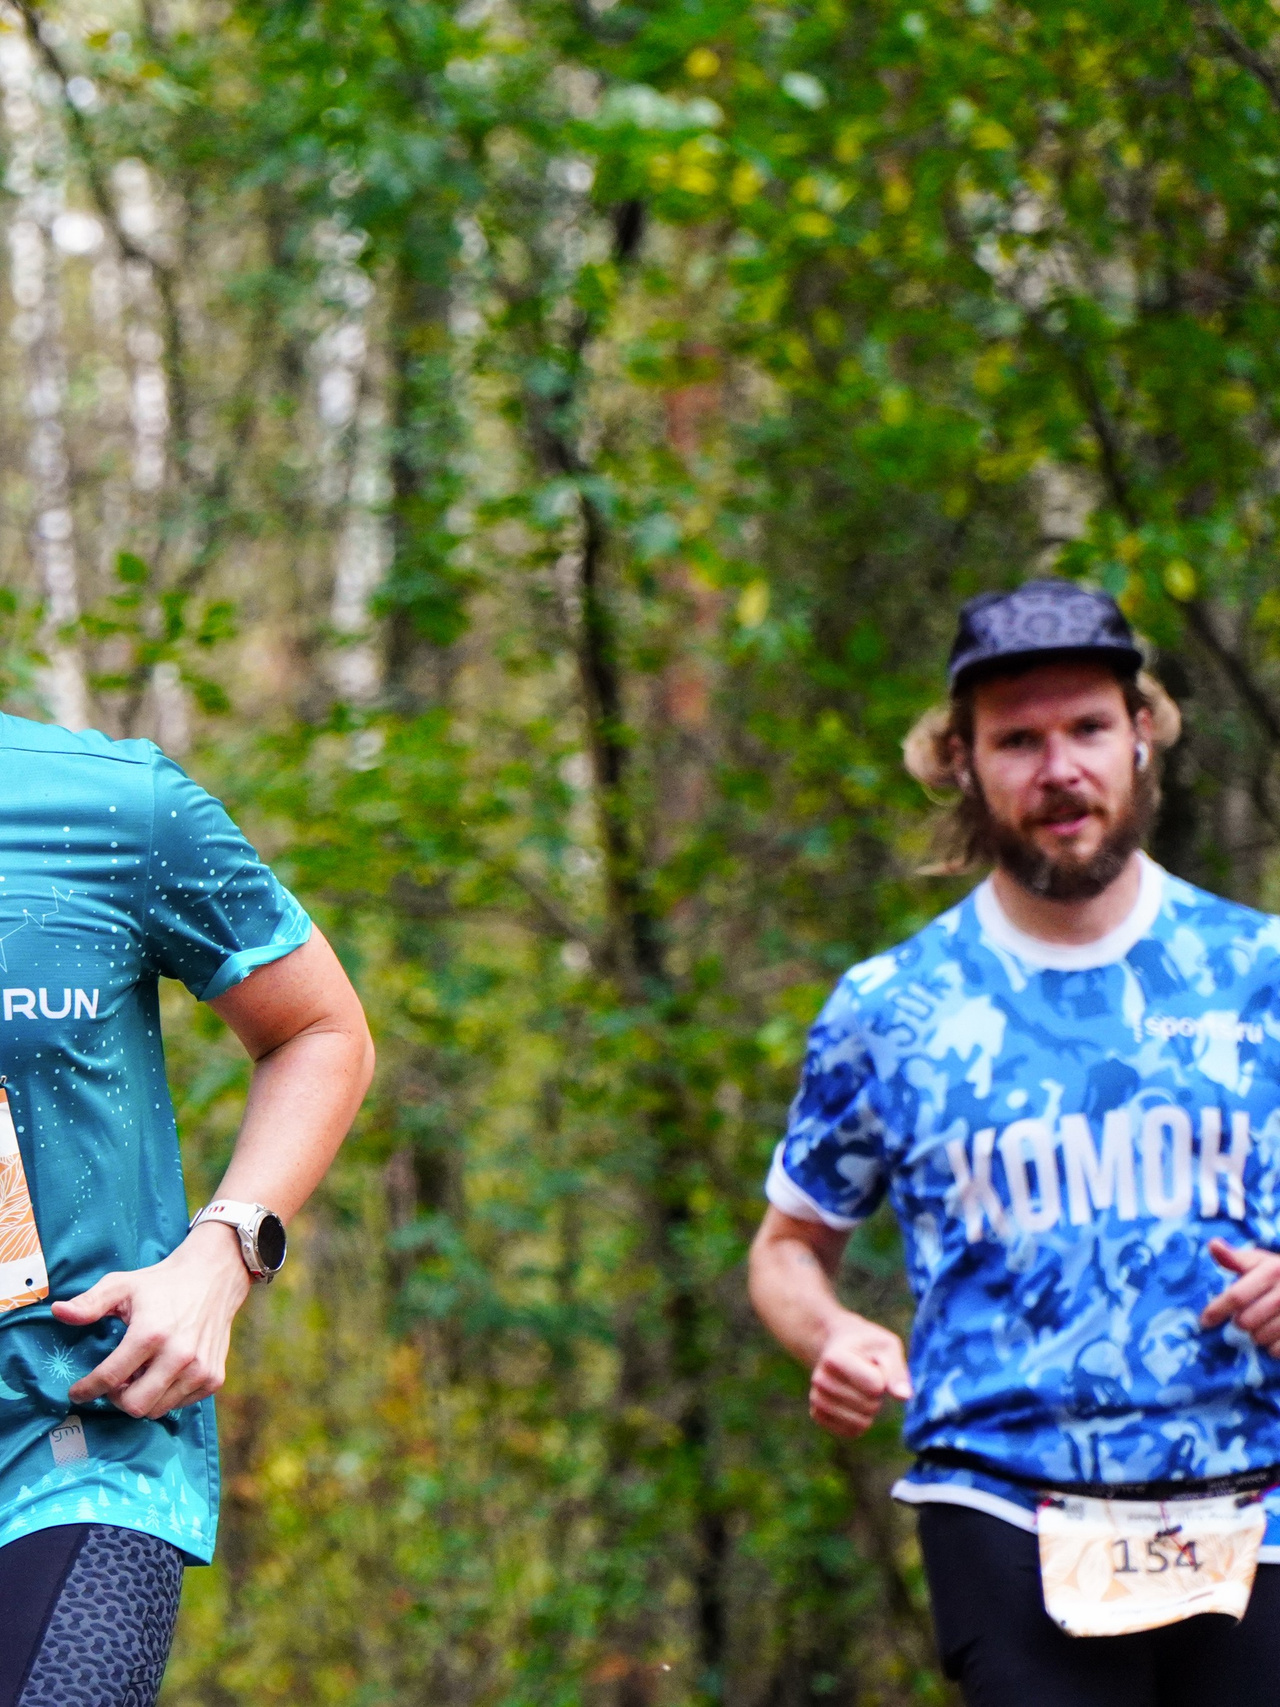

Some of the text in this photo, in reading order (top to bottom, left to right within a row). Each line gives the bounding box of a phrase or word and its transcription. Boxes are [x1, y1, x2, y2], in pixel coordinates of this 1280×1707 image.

[2, 987, 100, 1021] RUN
[944, 1105, 1252, 1243] КОМОН
[1112, 1537, 1203, 1574] 154
